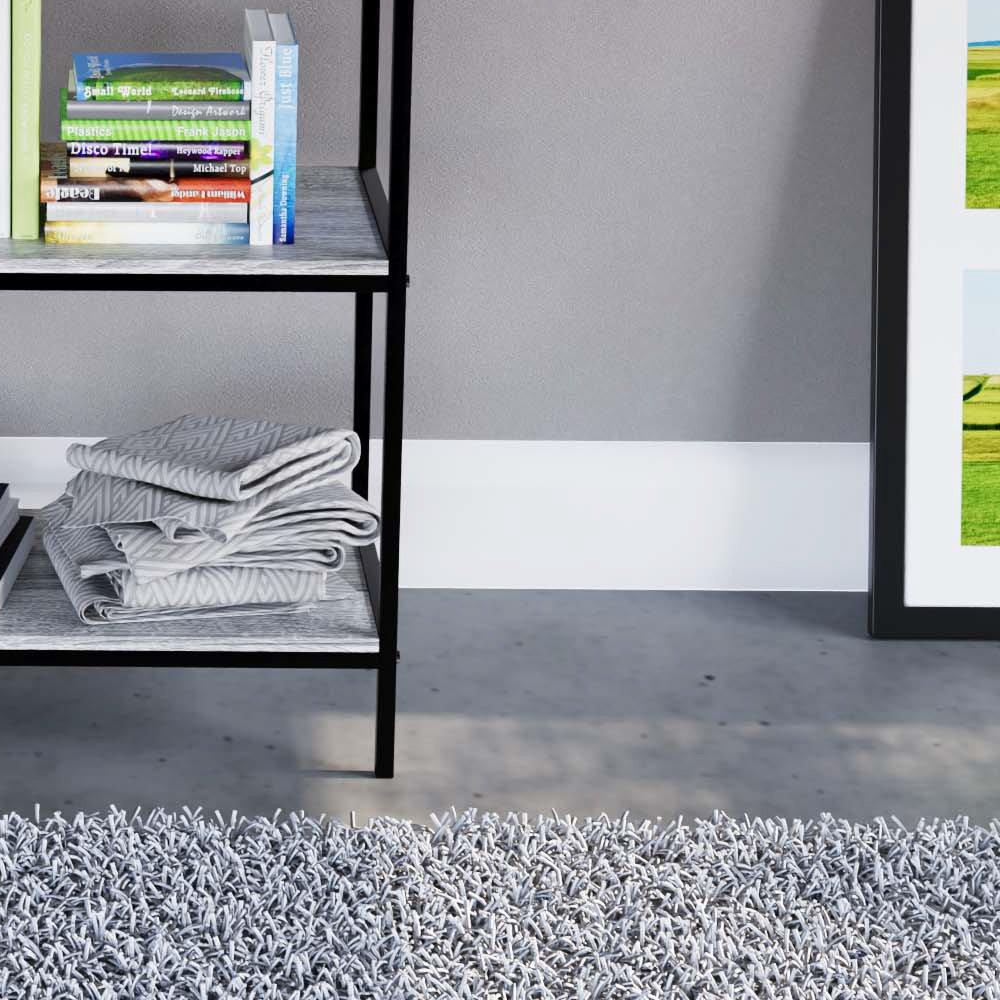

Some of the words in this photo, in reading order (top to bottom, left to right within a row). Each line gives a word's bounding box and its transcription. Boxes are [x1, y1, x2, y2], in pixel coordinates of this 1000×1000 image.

[279, 47, 293, 78] Blue
[84, 83, 114, 98] Small
[117, 85, 153, 98] World
[280, 81, 297, 109] Just
[66, 126, 113, 137] Plastics
[176, 126, 209, 137] Frank
[214, 126, 246, 137] Jason
[70, 142, 109, 155] Disco
[112, 142, 153, 156] Time!
[176, 144, 213, 156] Heywood
[193, 163, 228, 173] Michael
[229, 163, 247, 175] Top
[206, 189, 246, 199] William
[280, 173, 290, 206] Downing
[279, 207, 288, 242] Samantha
